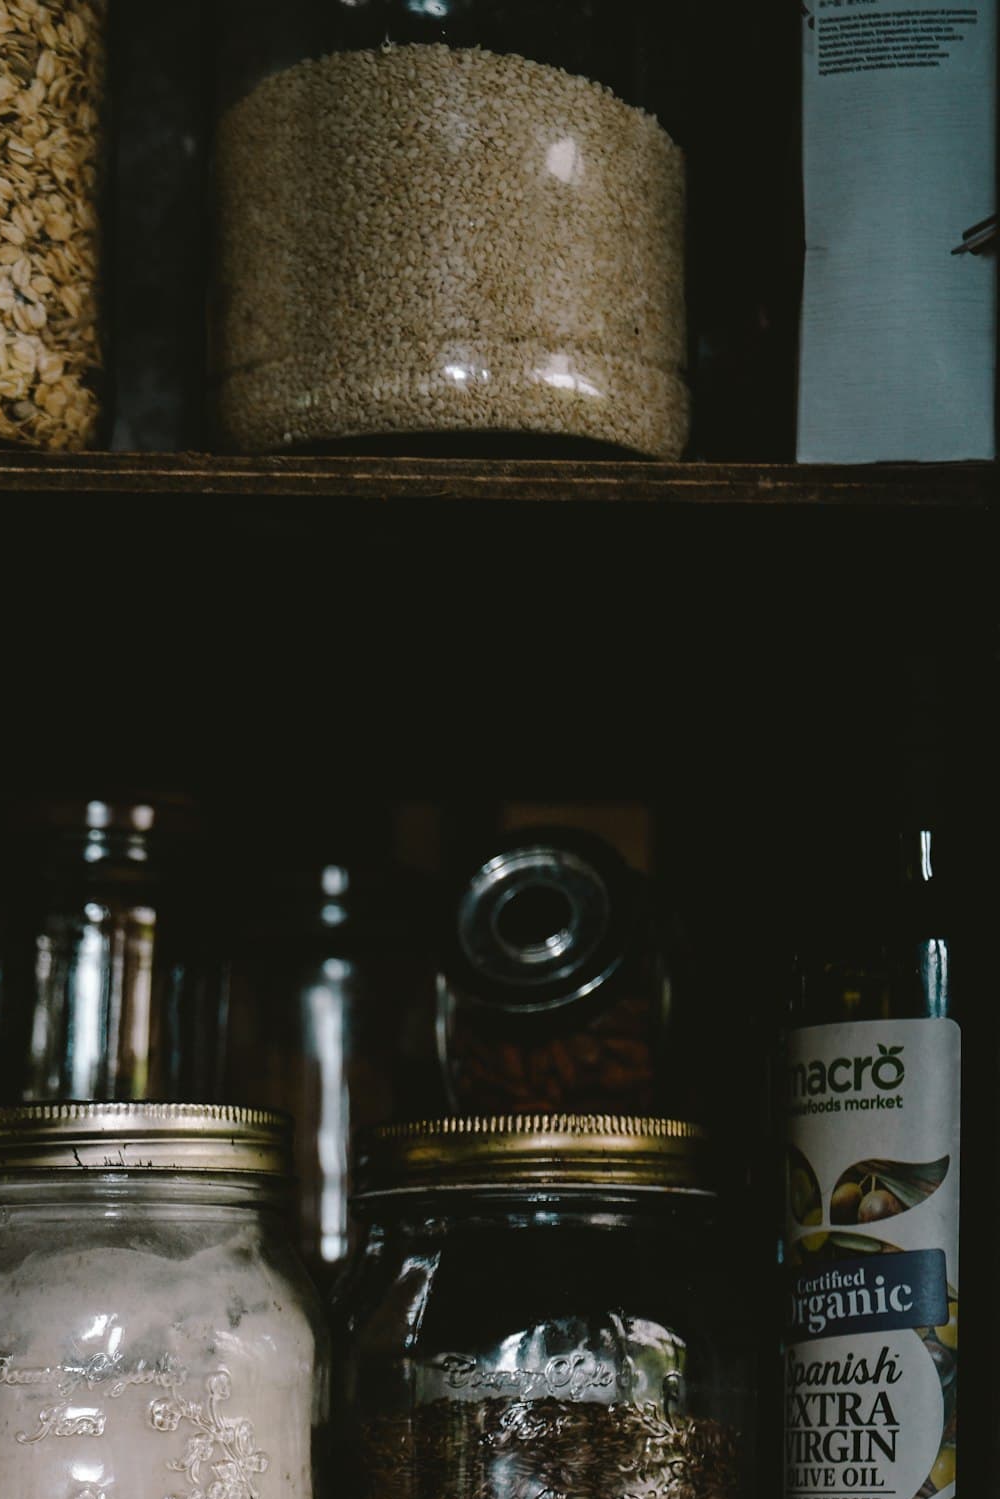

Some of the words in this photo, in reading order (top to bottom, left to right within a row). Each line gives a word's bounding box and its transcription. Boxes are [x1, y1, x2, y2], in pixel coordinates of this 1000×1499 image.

[844, 1094, 904, 1112] market
[796, 1266, 866, 1294] Certified
[787, 1346, 903, 1394] Spanish
[786, 1391, 900, 1428] EXTRA
[786, 1429, 900, 1464] VIRGIN
[787, 1467, 836, 1488] OLIVE
[842, 1467, 885, 1487] OIL
